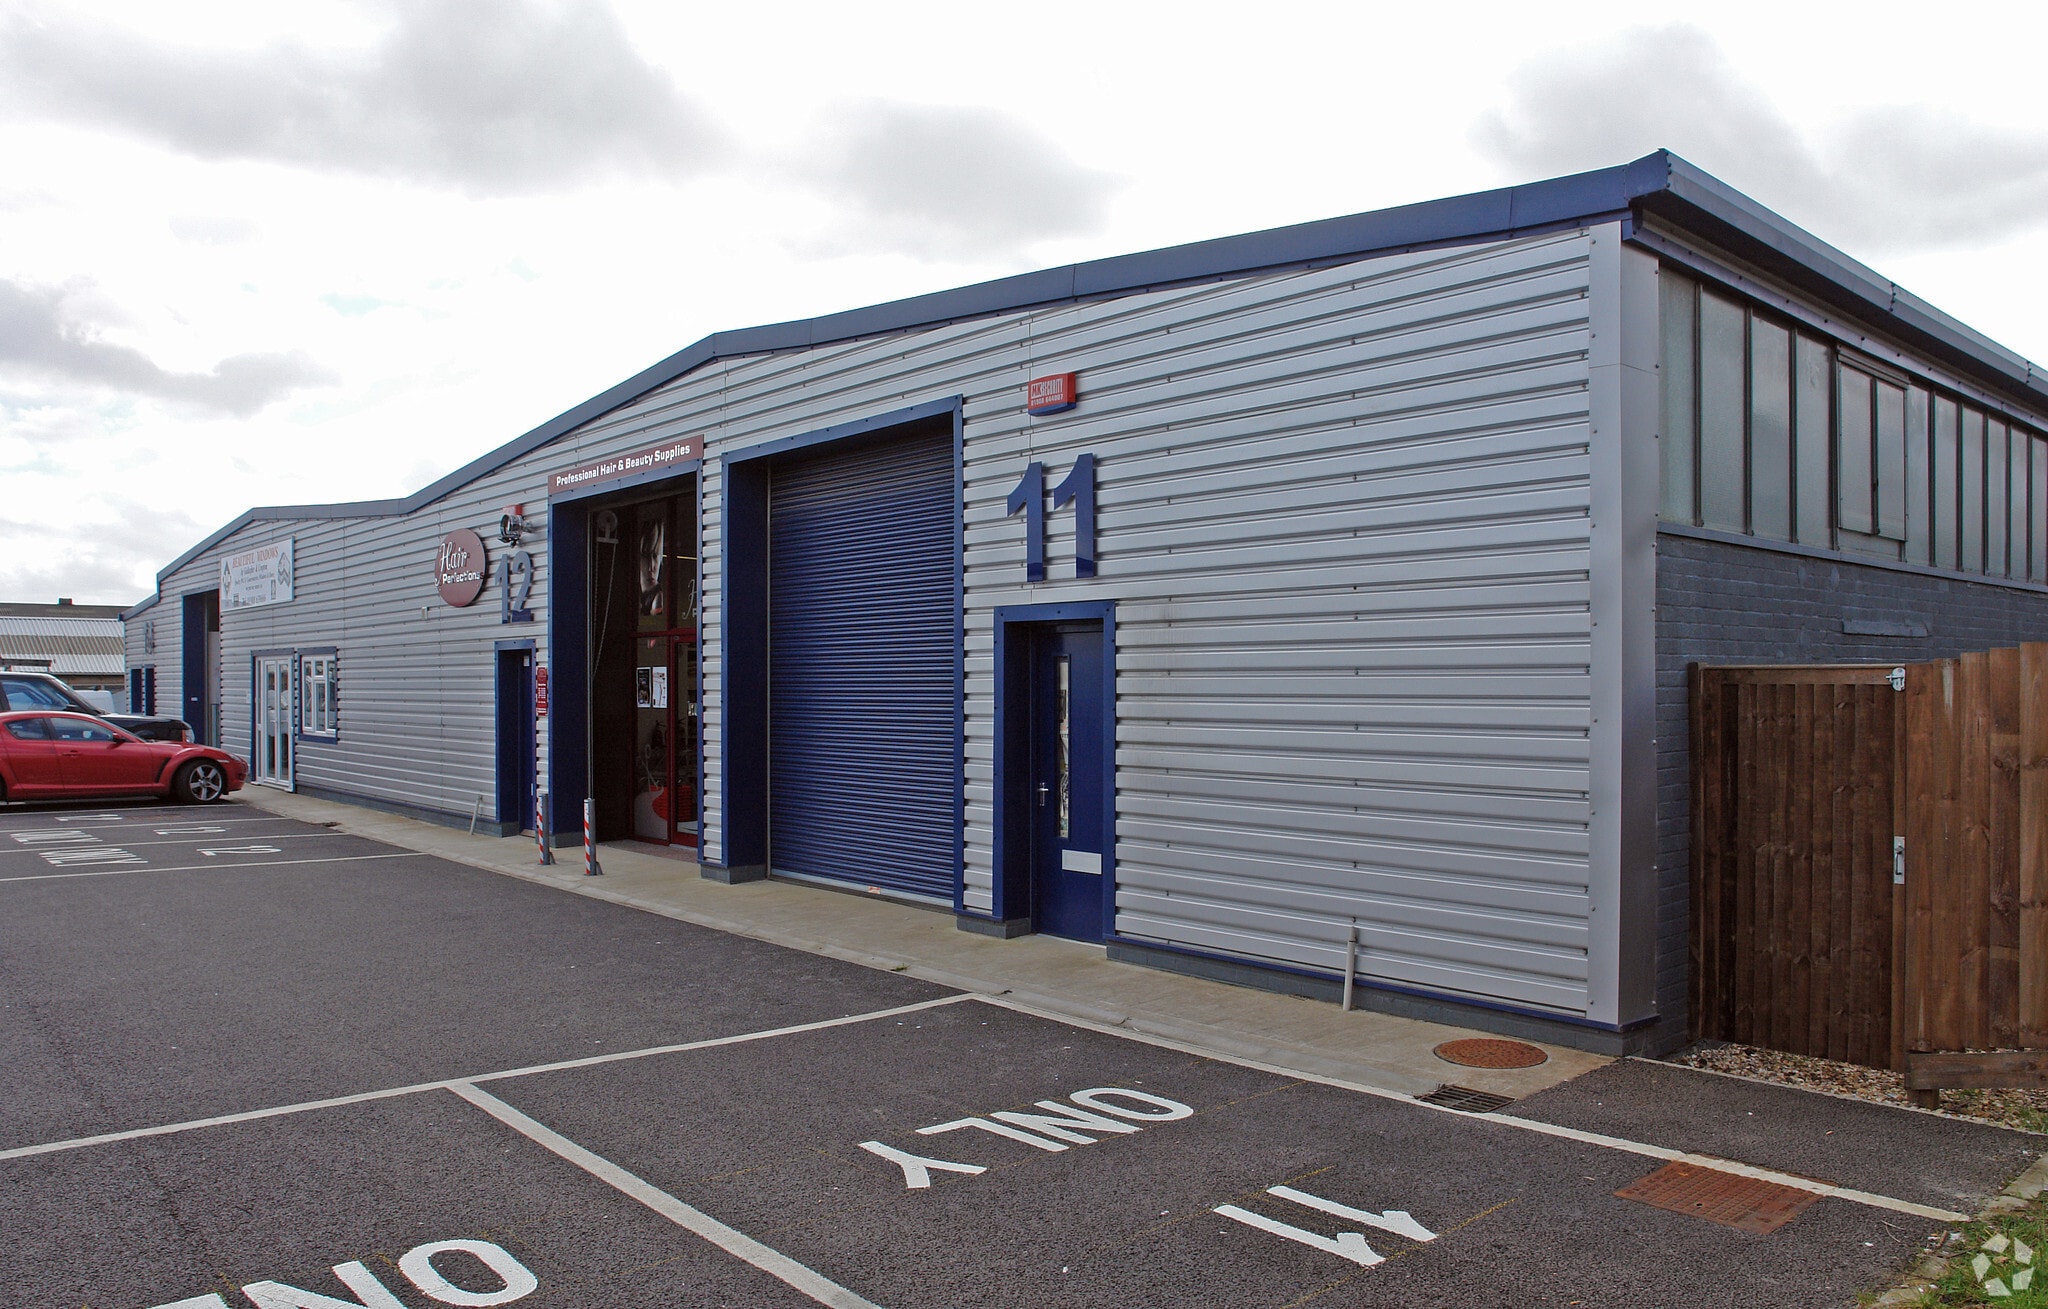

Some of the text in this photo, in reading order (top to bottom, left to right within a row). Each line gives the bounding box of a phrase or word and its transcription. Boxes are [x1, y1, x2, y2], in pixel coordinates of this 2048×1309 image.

[556, 444, 691, 487] Professional Hair & Beauty Supplies
[1007, 452, 1094, 583] 11
[436, 541, 468, 582] Hair
[442, 570, 484, 585] Perfections
[495, 550, 533, 624] 12
[858, 1087, 1194, 1190] ONLY
